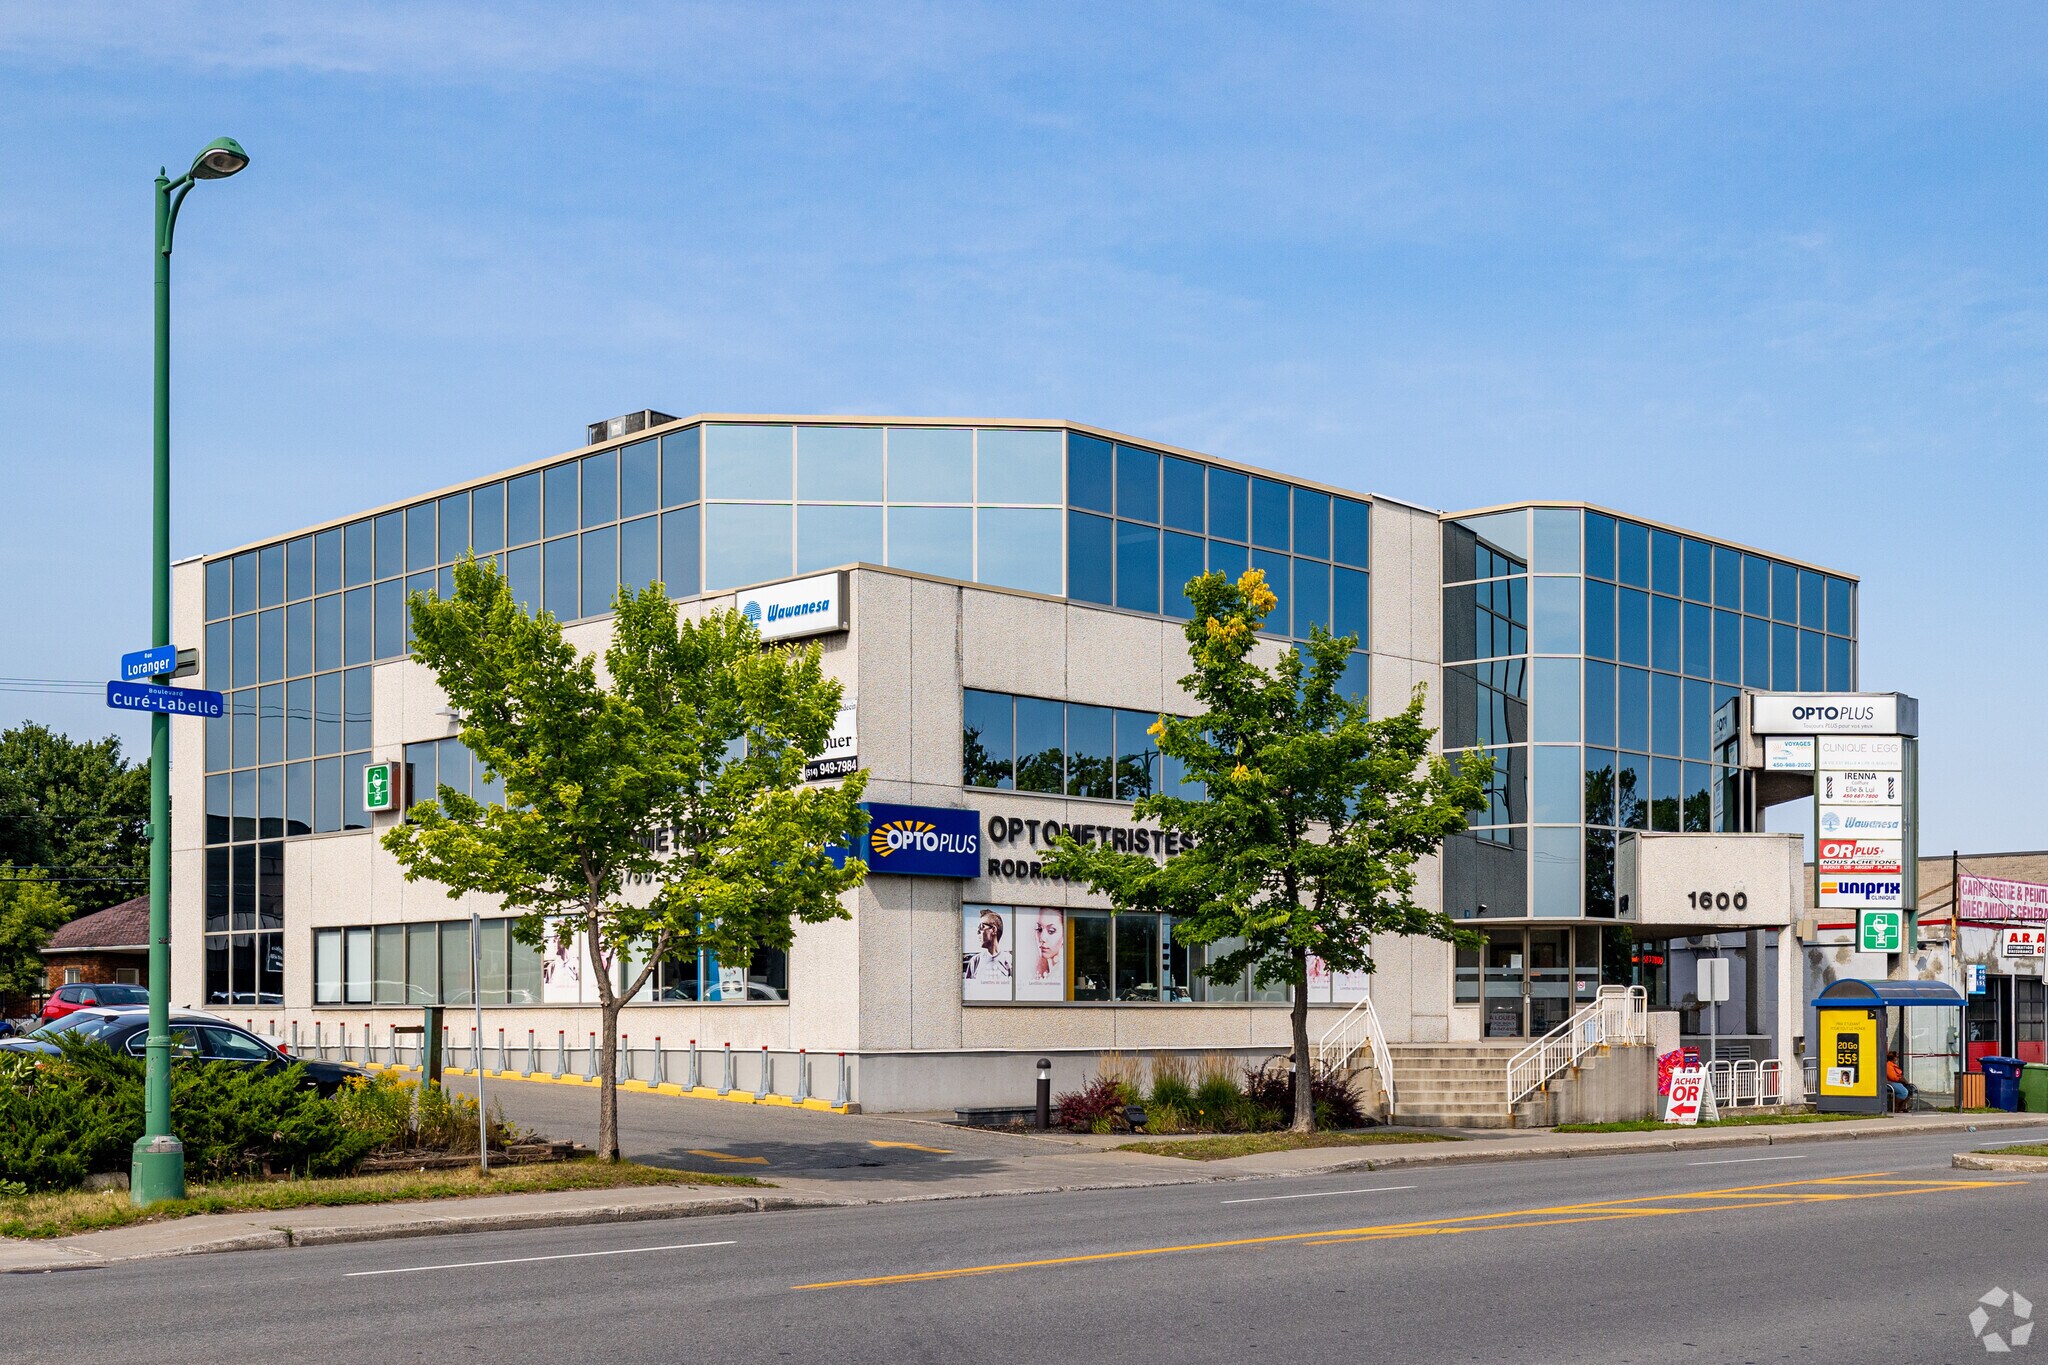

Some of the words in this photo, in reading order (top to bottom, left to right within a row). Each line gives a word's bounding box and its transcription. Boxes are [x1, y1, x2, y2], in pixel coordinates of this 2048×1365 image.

[767, 599, 830, 622] Wawanesa
[128, 658, 170, 676] Loranger
[148, 688, 184, 697] Boulevard
[112, 693, 219, 715] Curé-Labelle
[823, 735, 852, 750] ouer
[1822, 743, 1868, 753] CLINIQUE
[1871, 744, 1899, 753] LEGG
[805, 767, 819, 778] (514)
[820, 759, 857, 775] 949-7984
[1844, 772, 1877, 780] IRENNA
[1844, 817, 1899, 829] Wawanesa
[987, 815, 1195, 855] OPTOMETRISTES
[1822, 843, 1854, 858] OR
[1961, 879, 2015, 901] CARROSSERIE
[2017, 886, 2023, 901] &
[2025, 886, 2048, 904] PEINTU
[1687, 891, 1748, 910] 1600
[1962, 897, 2014, 919] MÉCANIQUE
[2009, 932, 2033, 943] A.R.
[1838, 1041, 1847, 1050] 20
[1674, 1077, 1702, 1085] ACHAT
[1672, 1085, 1699, 1102] OR
